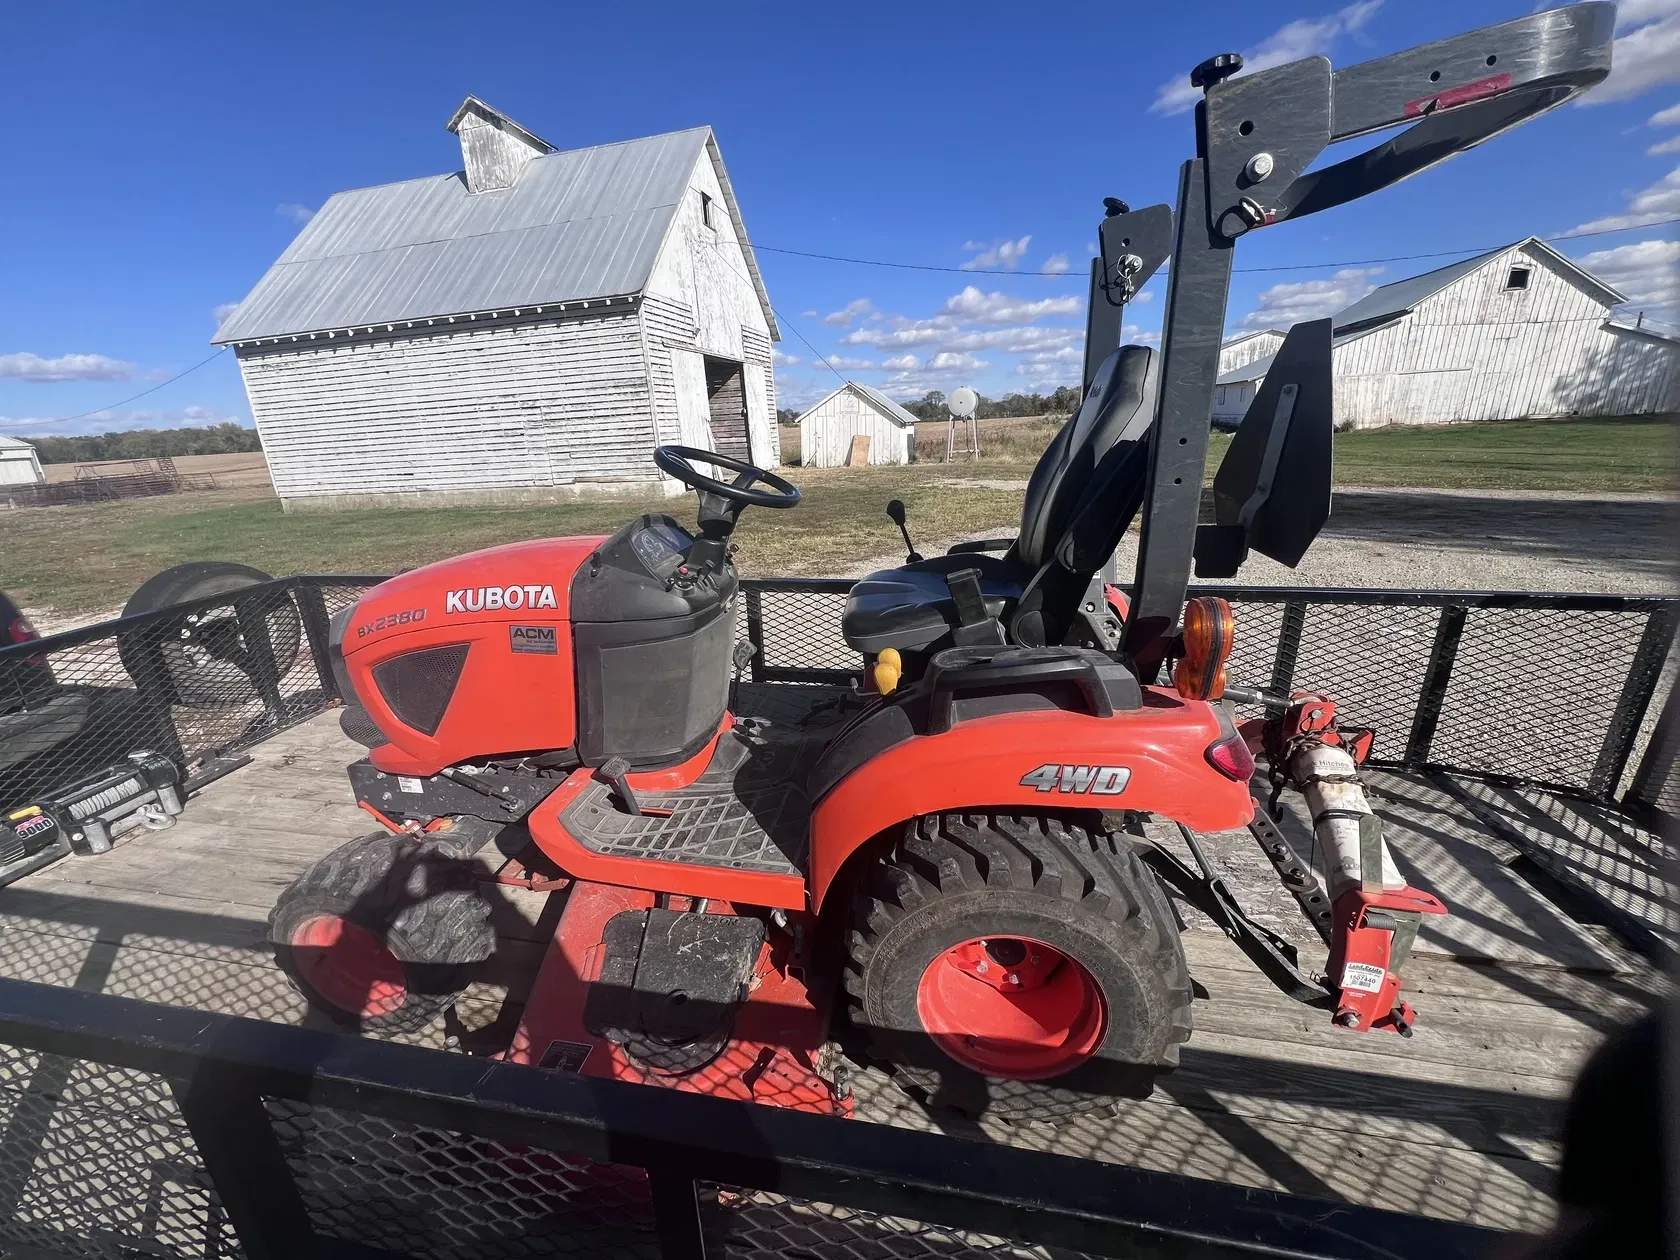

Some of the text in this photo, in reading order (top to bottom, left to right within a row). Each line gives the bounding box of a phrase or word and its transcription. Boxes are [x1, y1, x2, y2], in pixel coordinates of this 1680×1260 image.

[446, 585, 558, 614] KUBOTA
[358, 608, 428, 638] BX2380
[513, 627, 554, 640] ACM
[1019, 764, 1132, 795] 4WD
[17, 818, 54, 840] 9000
